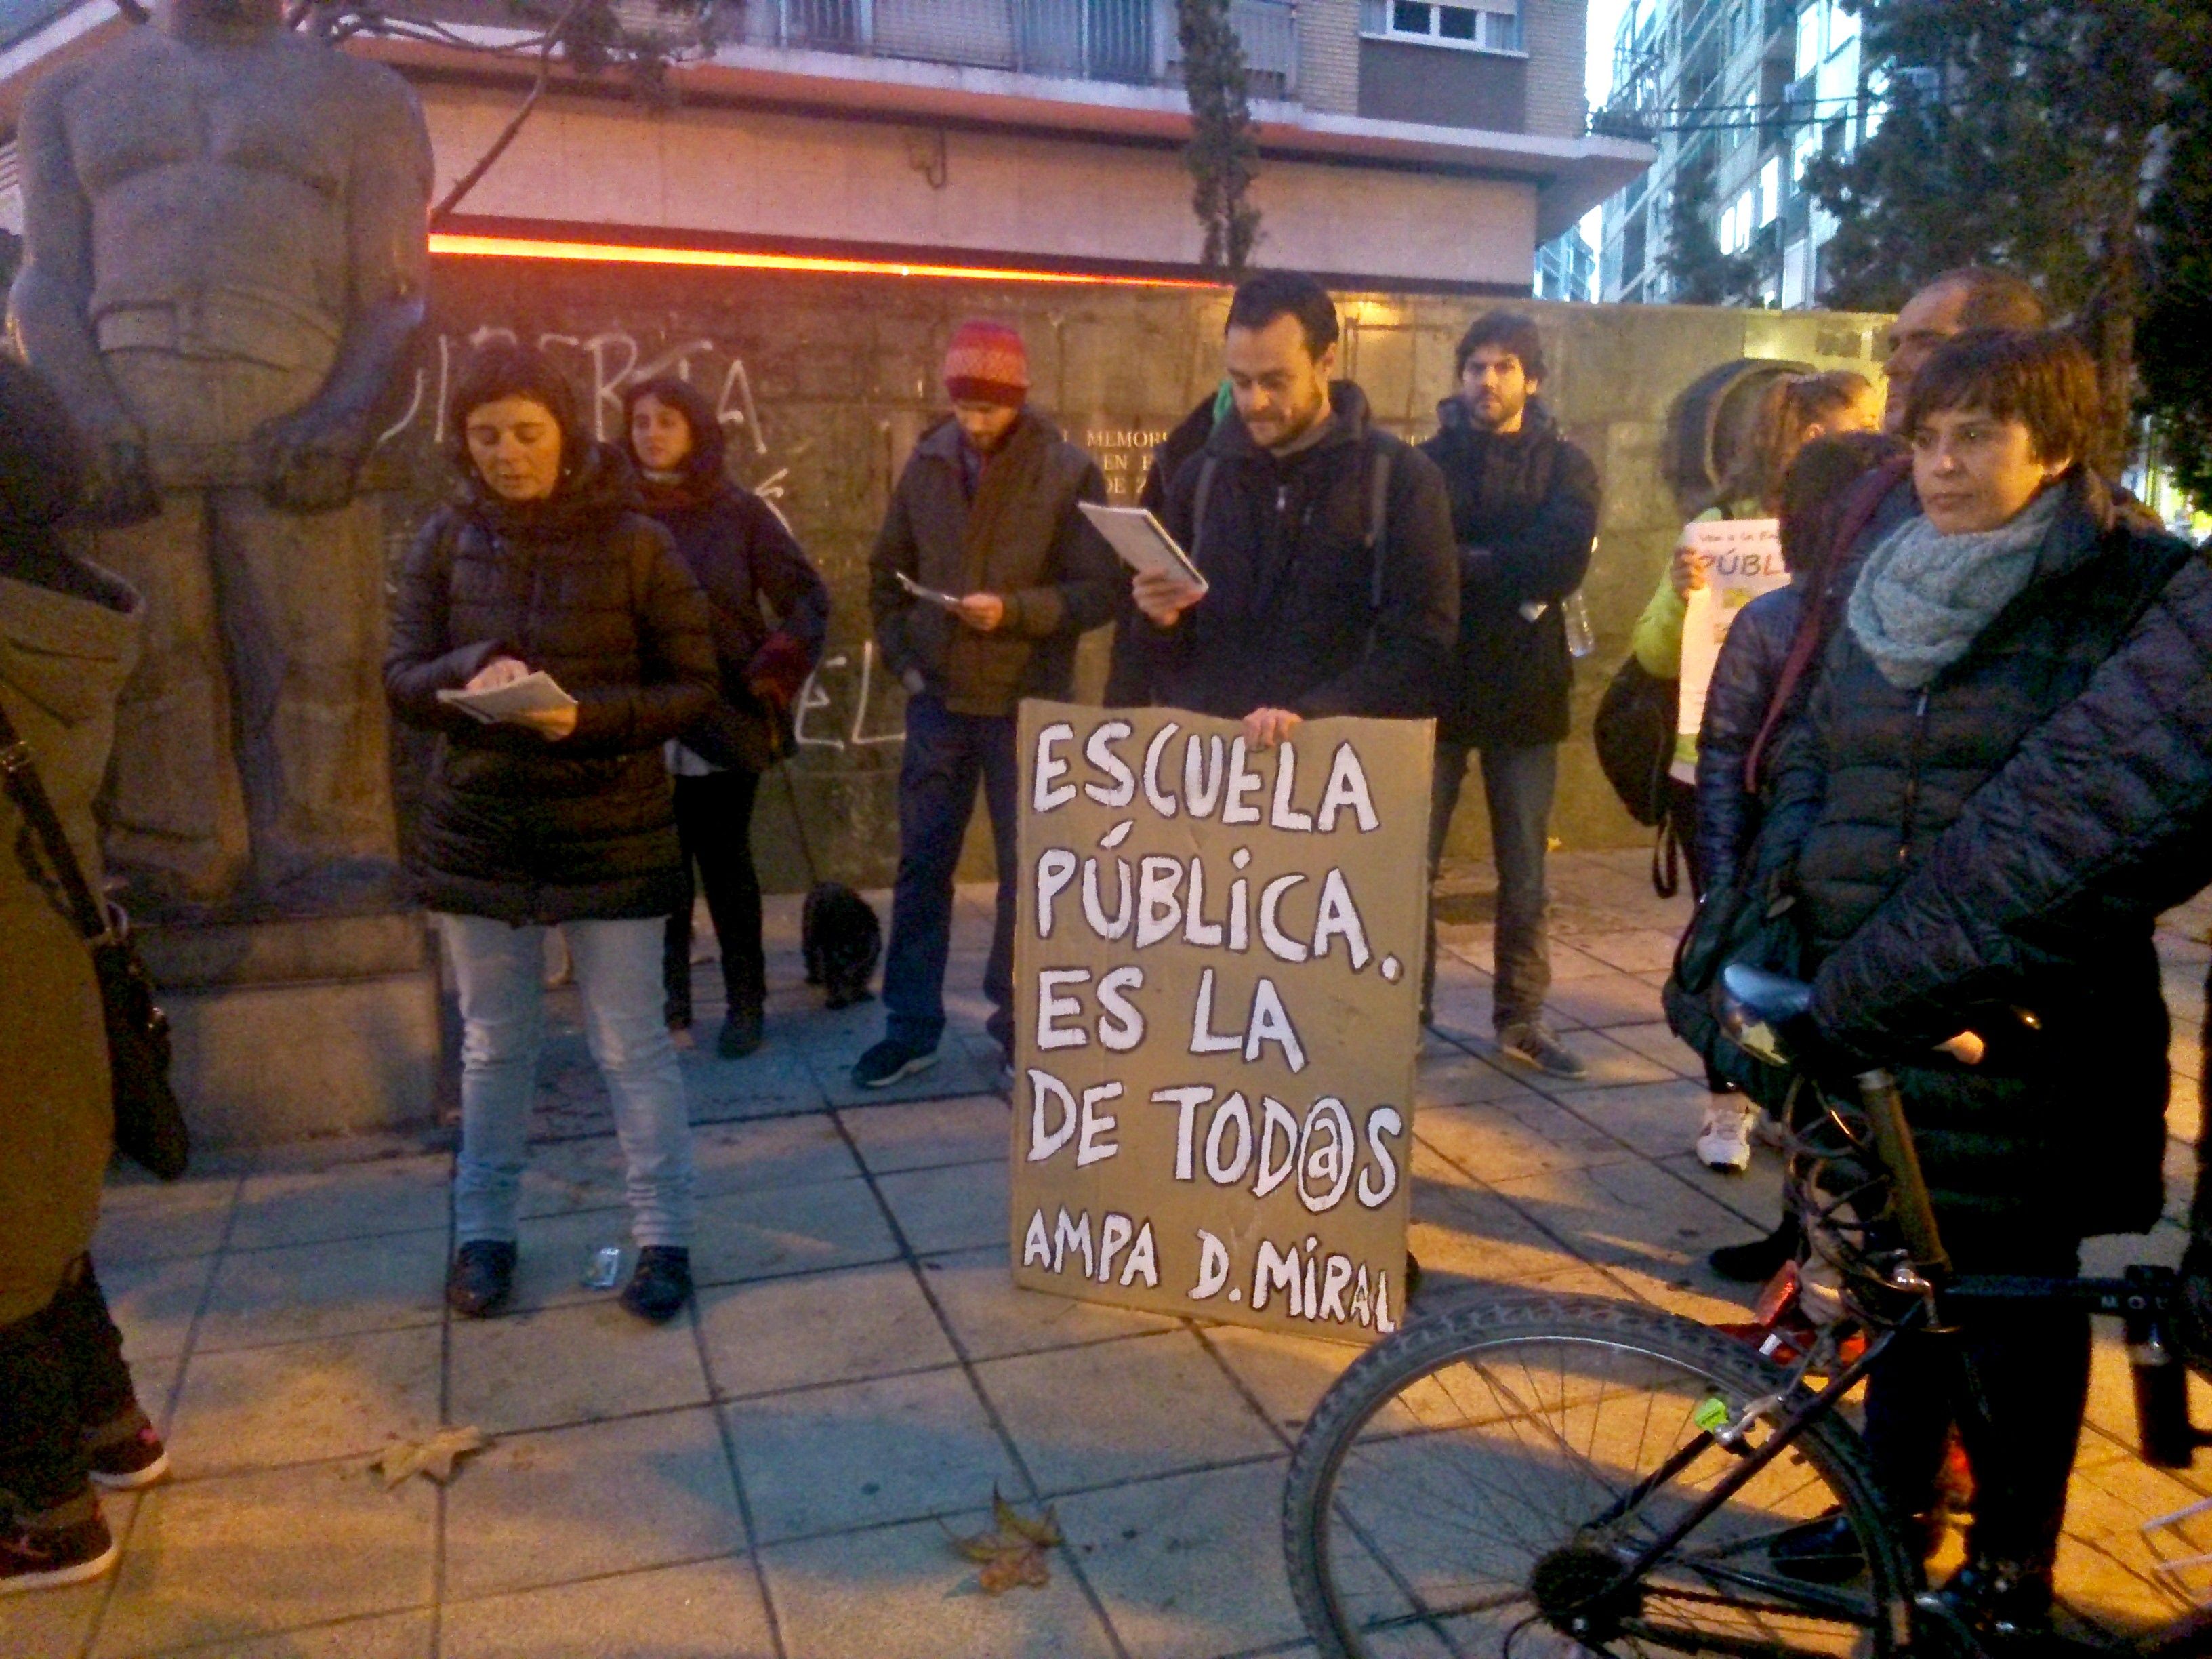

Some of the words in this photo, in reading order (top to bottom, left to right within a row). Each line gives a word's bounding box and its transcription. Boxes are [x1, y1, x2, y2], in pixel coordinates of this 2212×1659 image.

[1033, 721, 1380, 834] ESCUELA
[1037, 965, 1145, 1051] ES
[1189, 968, 1307, 1074] LA
[1026, 1069, 1126, 1168] DE
[1151, 1084, 1405, 1214] TOD@S
[1023, 1208, 1158, 1288] AMPA
